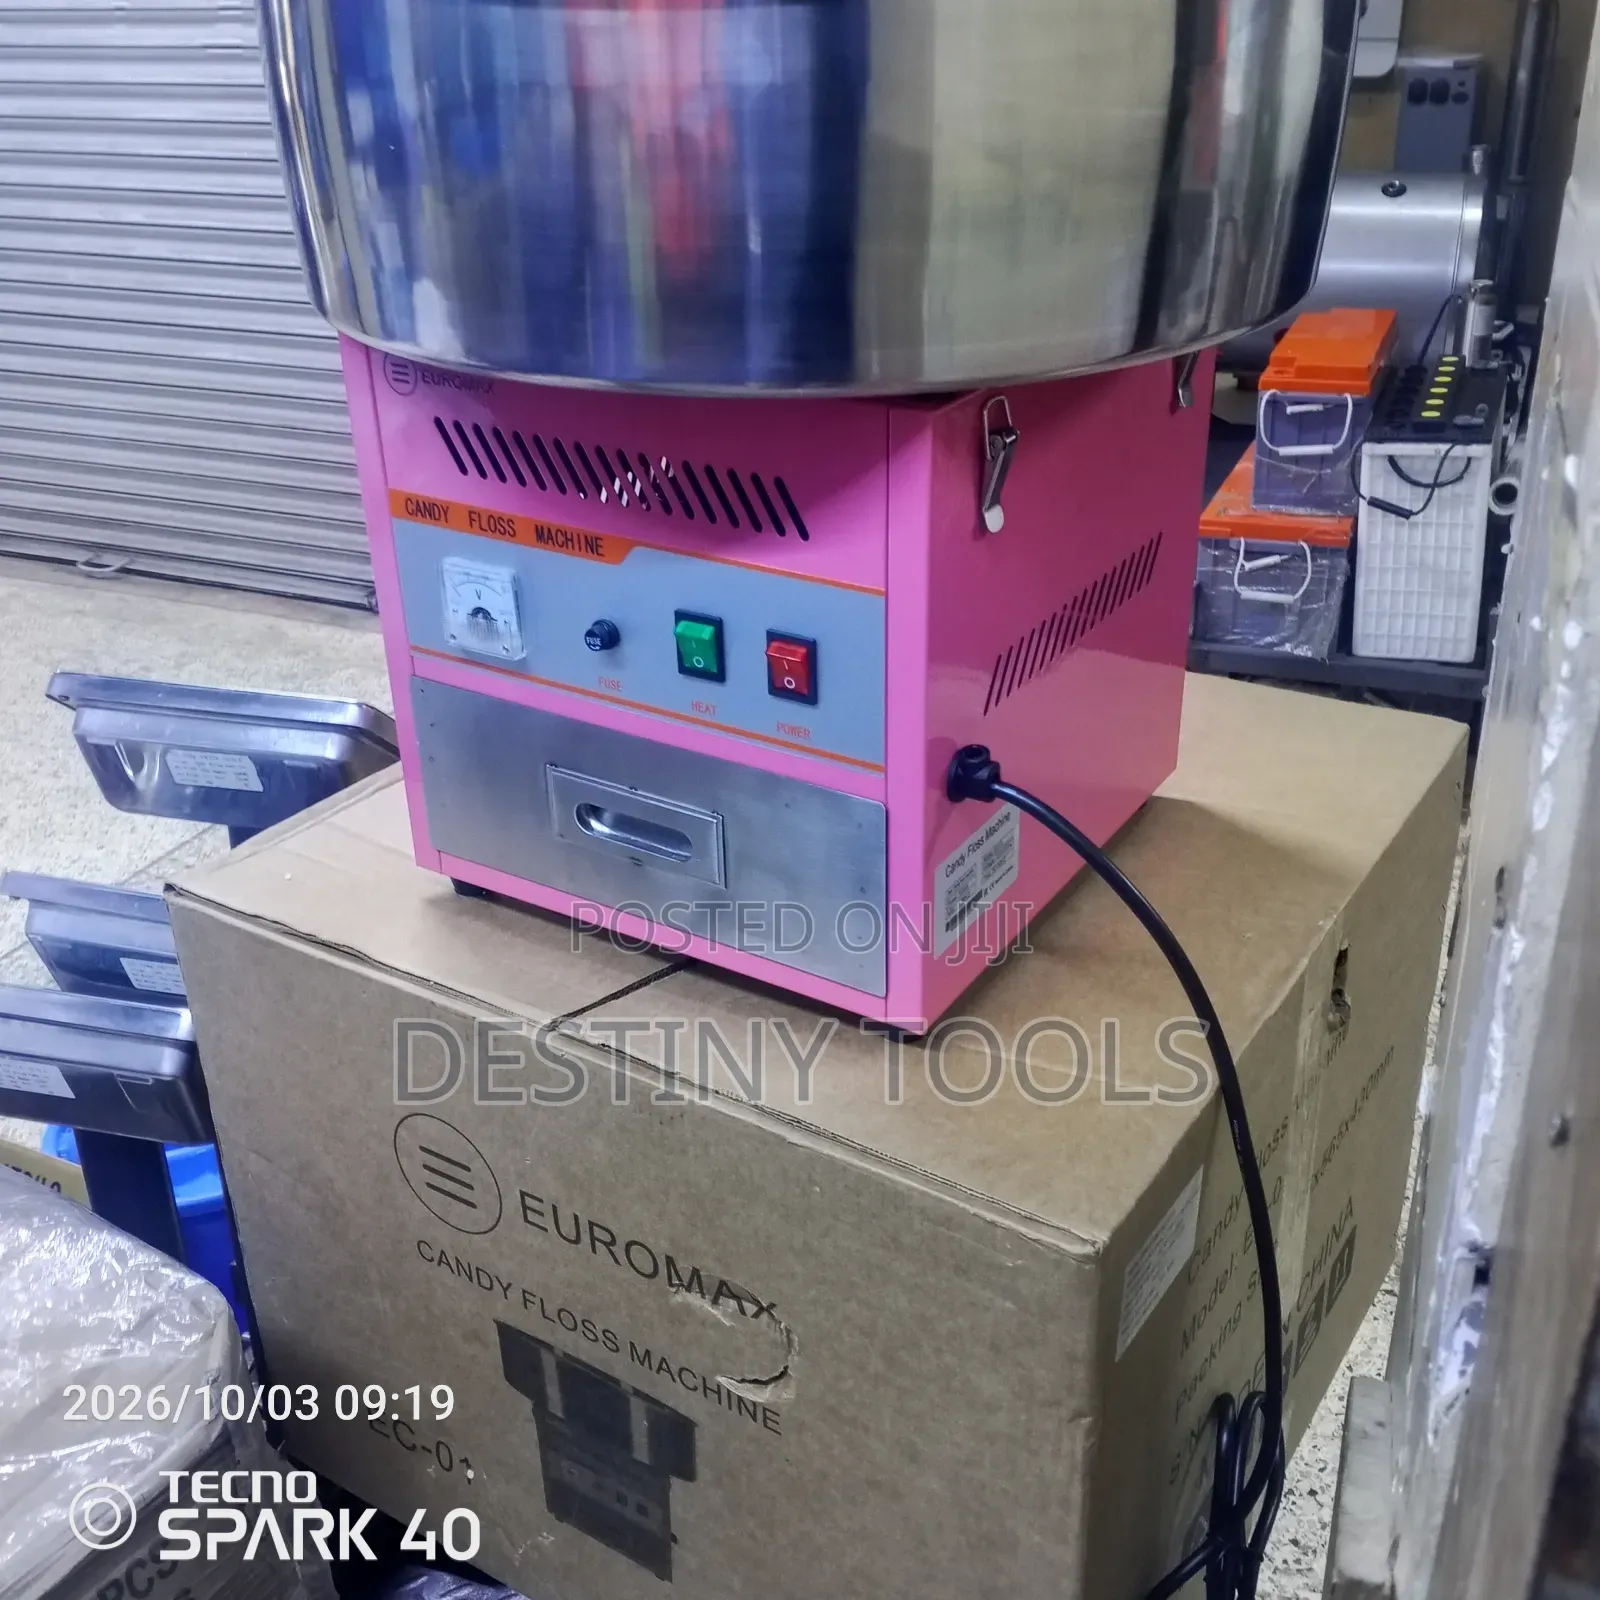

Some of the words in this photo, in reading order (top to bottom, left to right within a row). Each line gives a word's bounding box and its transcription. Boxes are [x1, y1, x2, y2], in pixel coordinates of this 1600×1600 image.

[420, 371, 496, 396] EUROMAX
[404, 497, 450, 524] CANDY
[468, 509, 517, 538] FLOSS
[535, 523, 605, 557] MACHINE
[474, 588, 482, 601] V
[586, 636, 603, 647] FUSE
[598, 676, 623, 692] FUSE
[691, 700, 717, 717] HEAT
[776, 721, 811, 741] POWER
[1188, 1183, 1245, 1285] Candy
[1255, 1115, 1289, 1172] loss
[518, 1189, 778, 1320] EUROMAX
[1296, 1195, 1354, 1313] CHINA
[416, 1239, 512, 1301] CANDY
[521, 1288, 620, 1353] FLOSS
[629, 1340, 783, 1436] MACHINE
[1174, 1301, 1242, 1423] Packing
